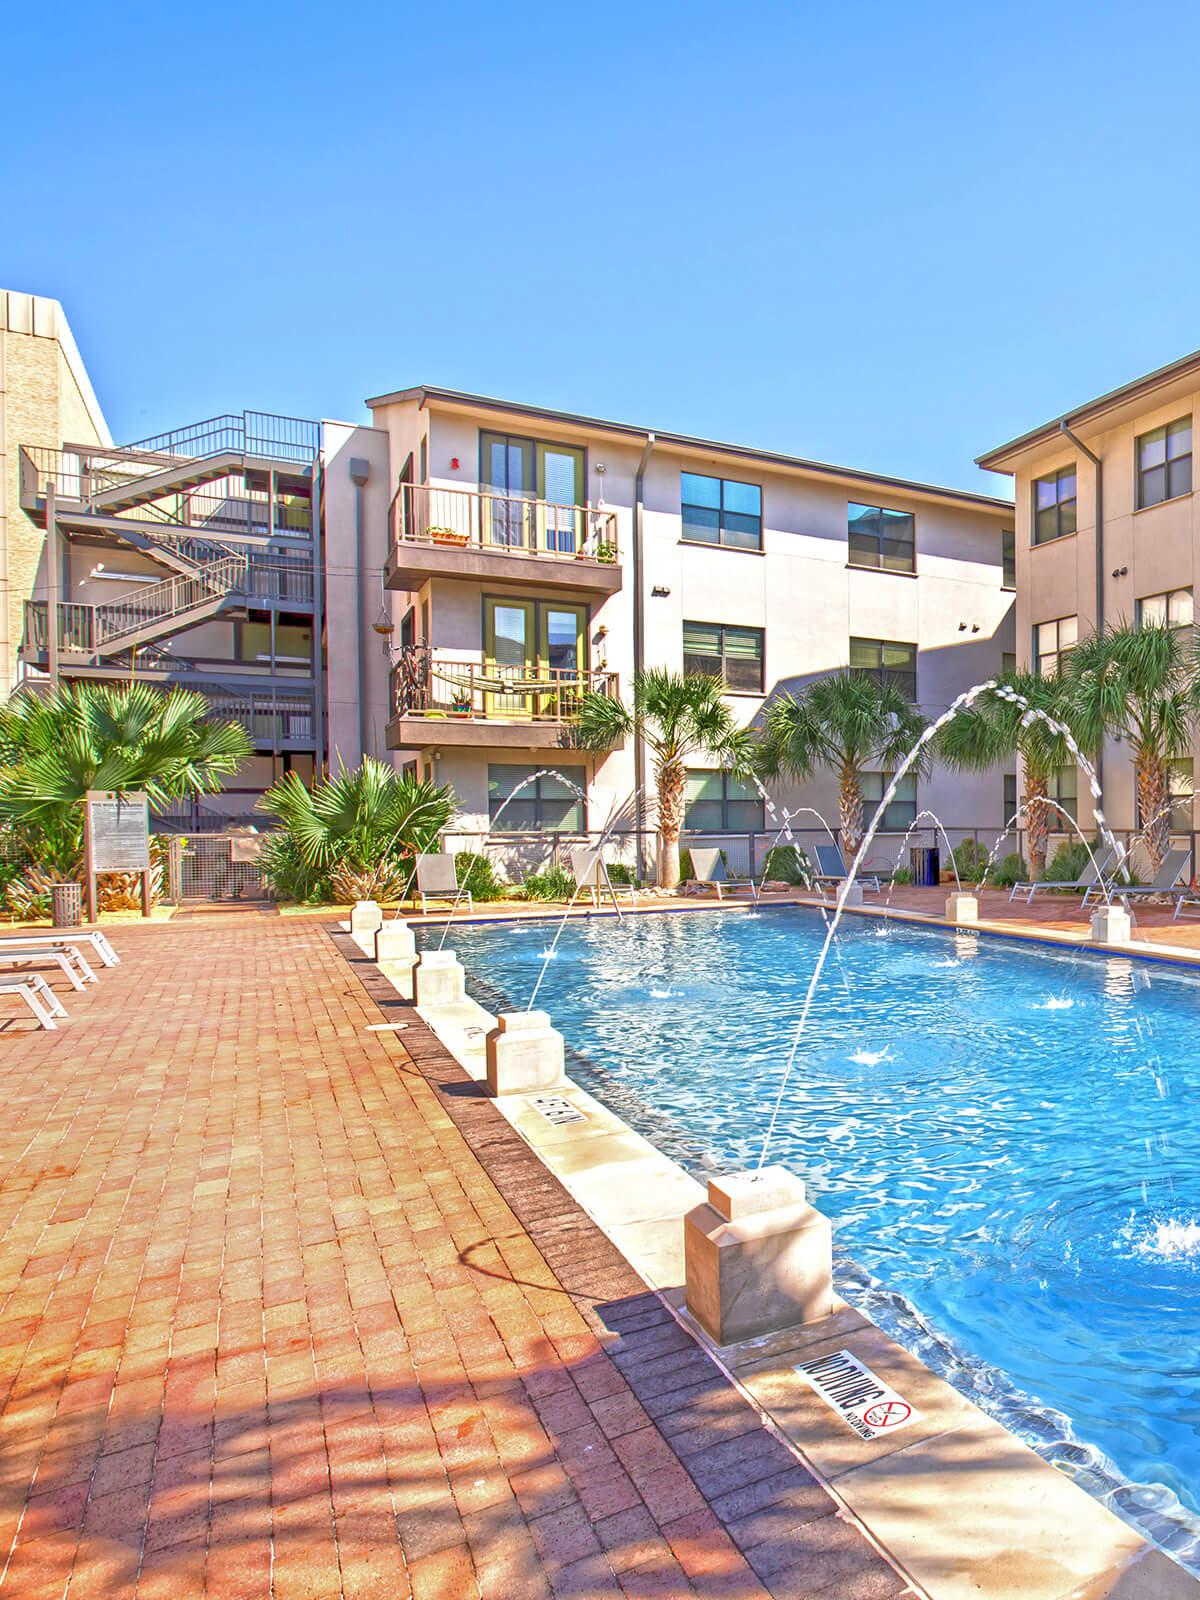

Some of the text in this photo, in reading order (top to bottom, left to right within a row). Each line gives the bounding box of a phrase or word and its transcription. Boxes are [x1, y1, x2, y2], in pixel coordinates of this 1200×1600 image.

[549, 1114, 585, 1126] IN
[799, 1352, 886, 1410] NO DIVING
[844, 1412, 858, 1422] NO
[851, 1418, 875, 1438] DIVING
